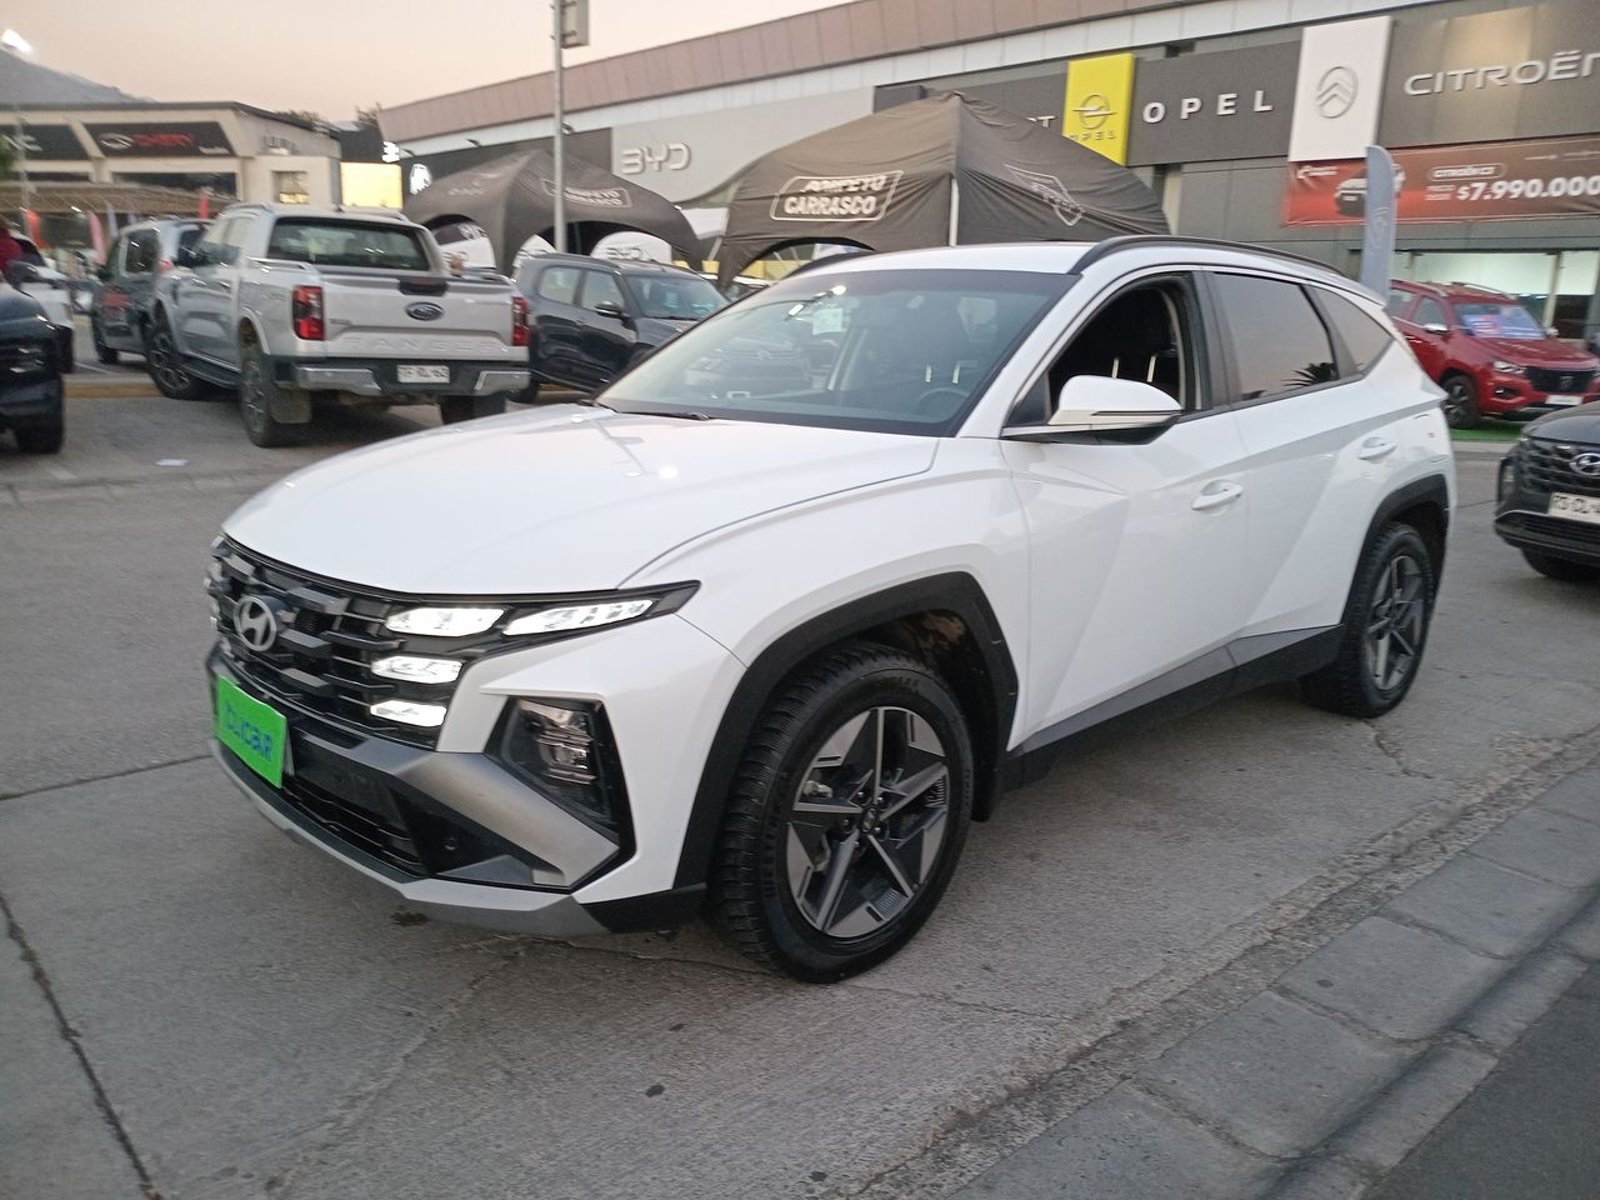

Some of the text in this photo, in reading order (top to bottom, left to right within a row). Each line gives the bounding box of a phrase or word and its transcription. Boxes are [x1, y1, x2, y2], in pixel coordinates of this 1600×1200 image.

[1142, 90, 1273, 124] OPEL
[621, 142, 691, 175] BYD
[1457, 175, 1600, 200] $7.990.000
[784, 195, 877, 215] CARRASCO
